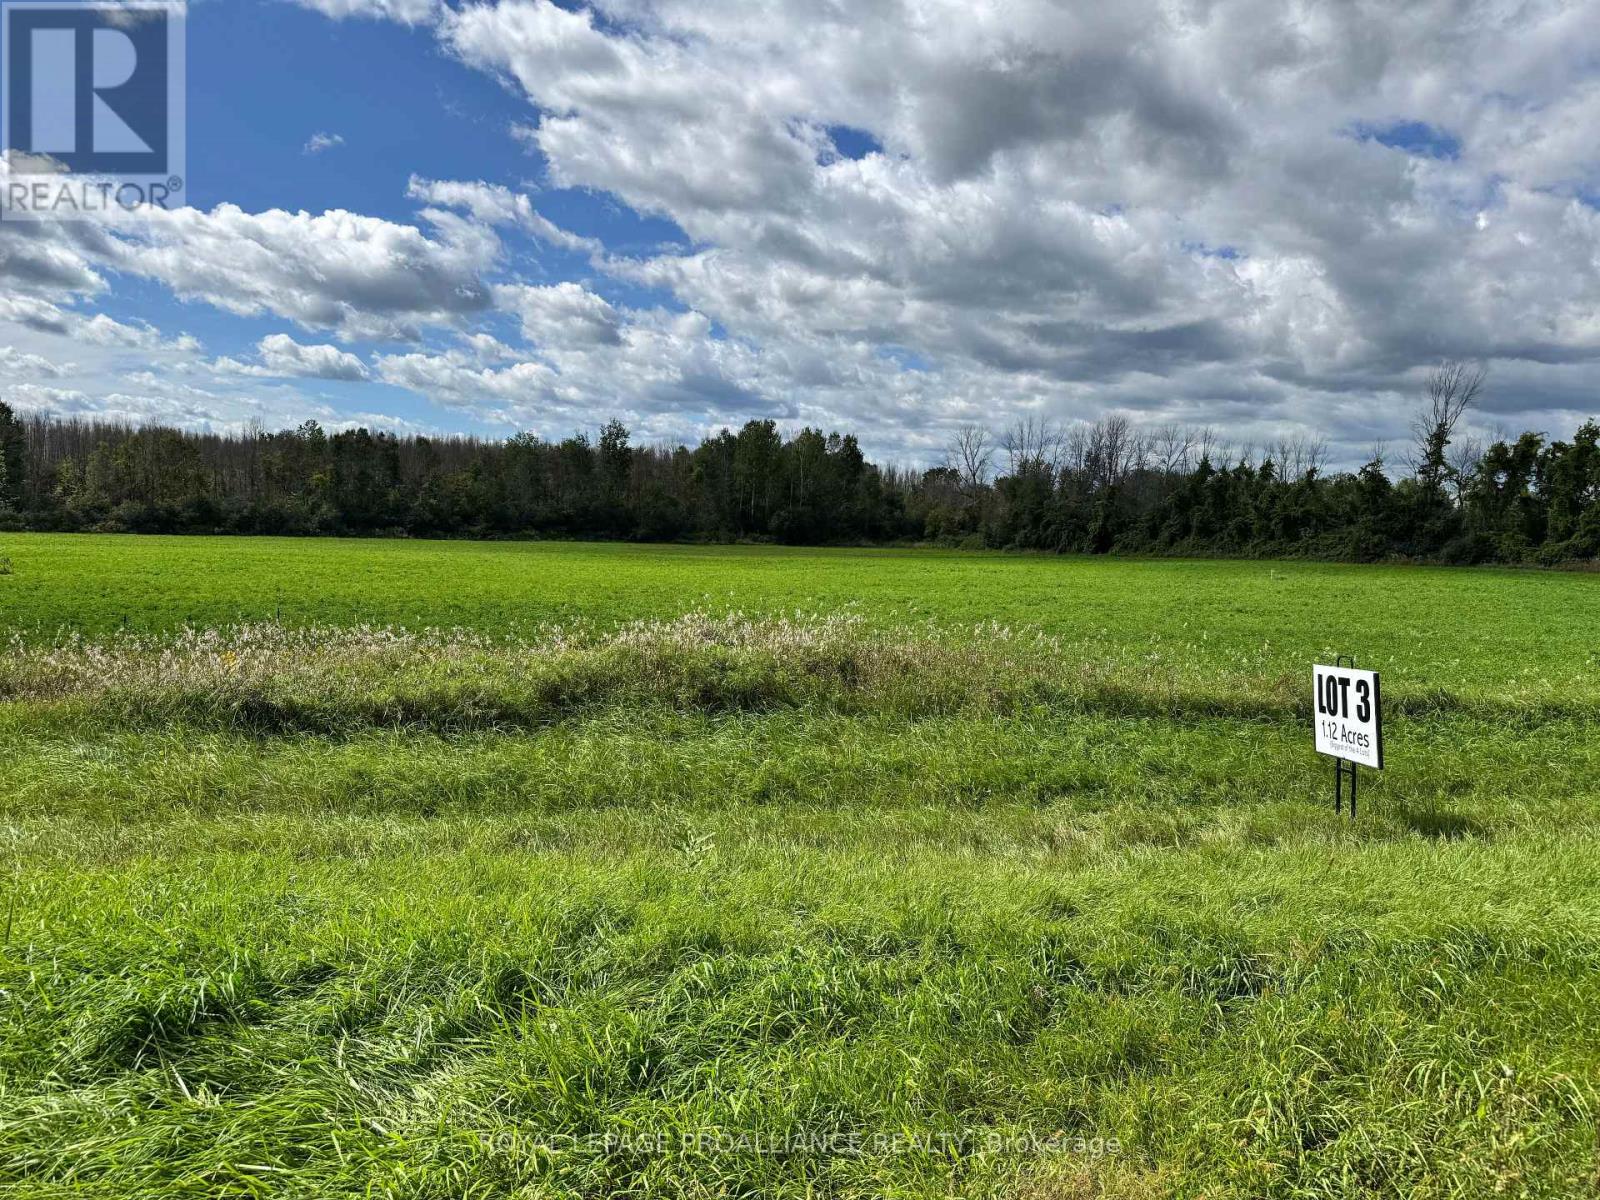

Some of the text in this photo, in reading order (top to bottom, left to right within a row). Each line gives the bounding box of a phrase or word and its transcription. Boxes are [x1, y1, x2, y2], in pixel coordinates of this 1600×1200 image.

[1318, 674, 1371, 723] LOT 3
[1322, 720, 1370, 748] 1.12 Acres
